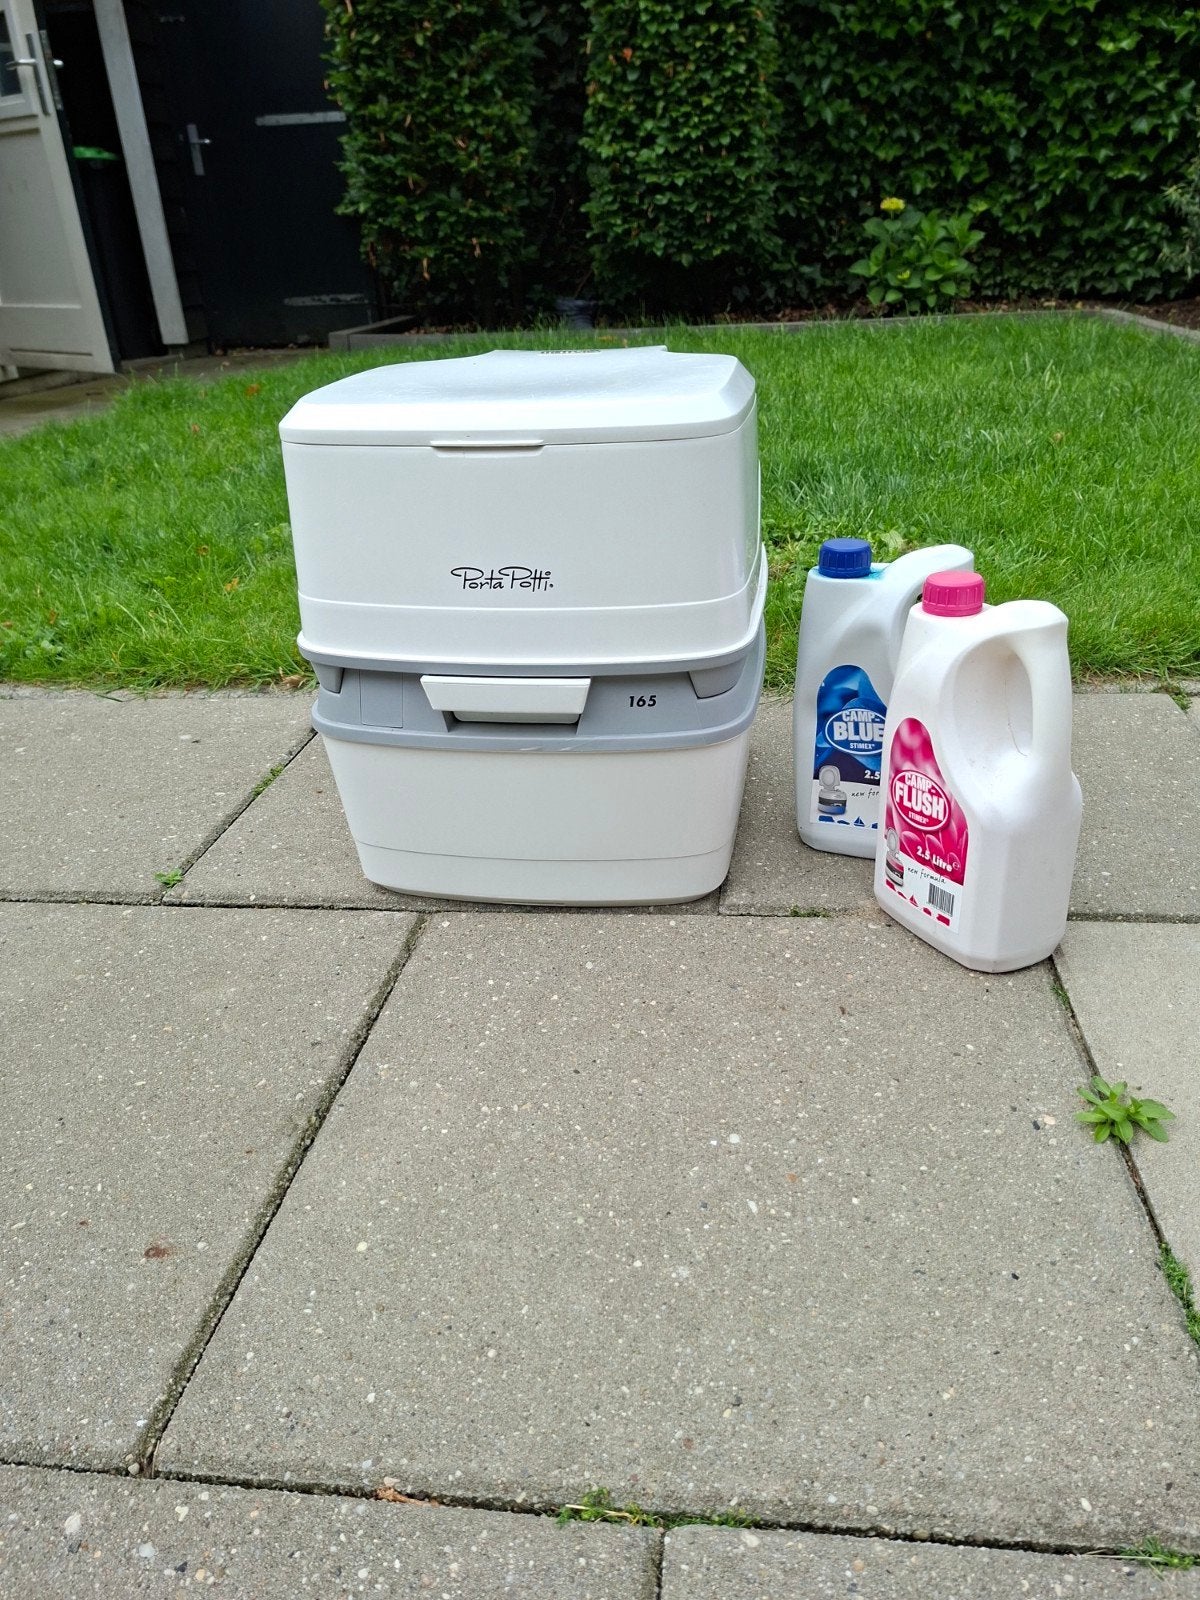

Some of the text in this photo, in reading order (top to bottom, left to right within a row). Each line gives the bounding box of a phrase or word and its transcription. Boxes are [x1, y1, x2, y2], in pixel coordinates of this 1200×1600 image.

[450, 566, 504, 590] Porta
[629, 694, 657, 708] 165
[841, 710, 881, 722] CAMP-
[833, 721, 885, 742] BLUE
[863, 770, 881, 780] 2.5
[904, 772, 937, 793] CAMP-
[851, 790, 865, 798] new
[895, 780, 945, 821] FLUSH
[916, 845, 953, 872] 2.5 Litre
[907, 866, 946, 884] new formula
